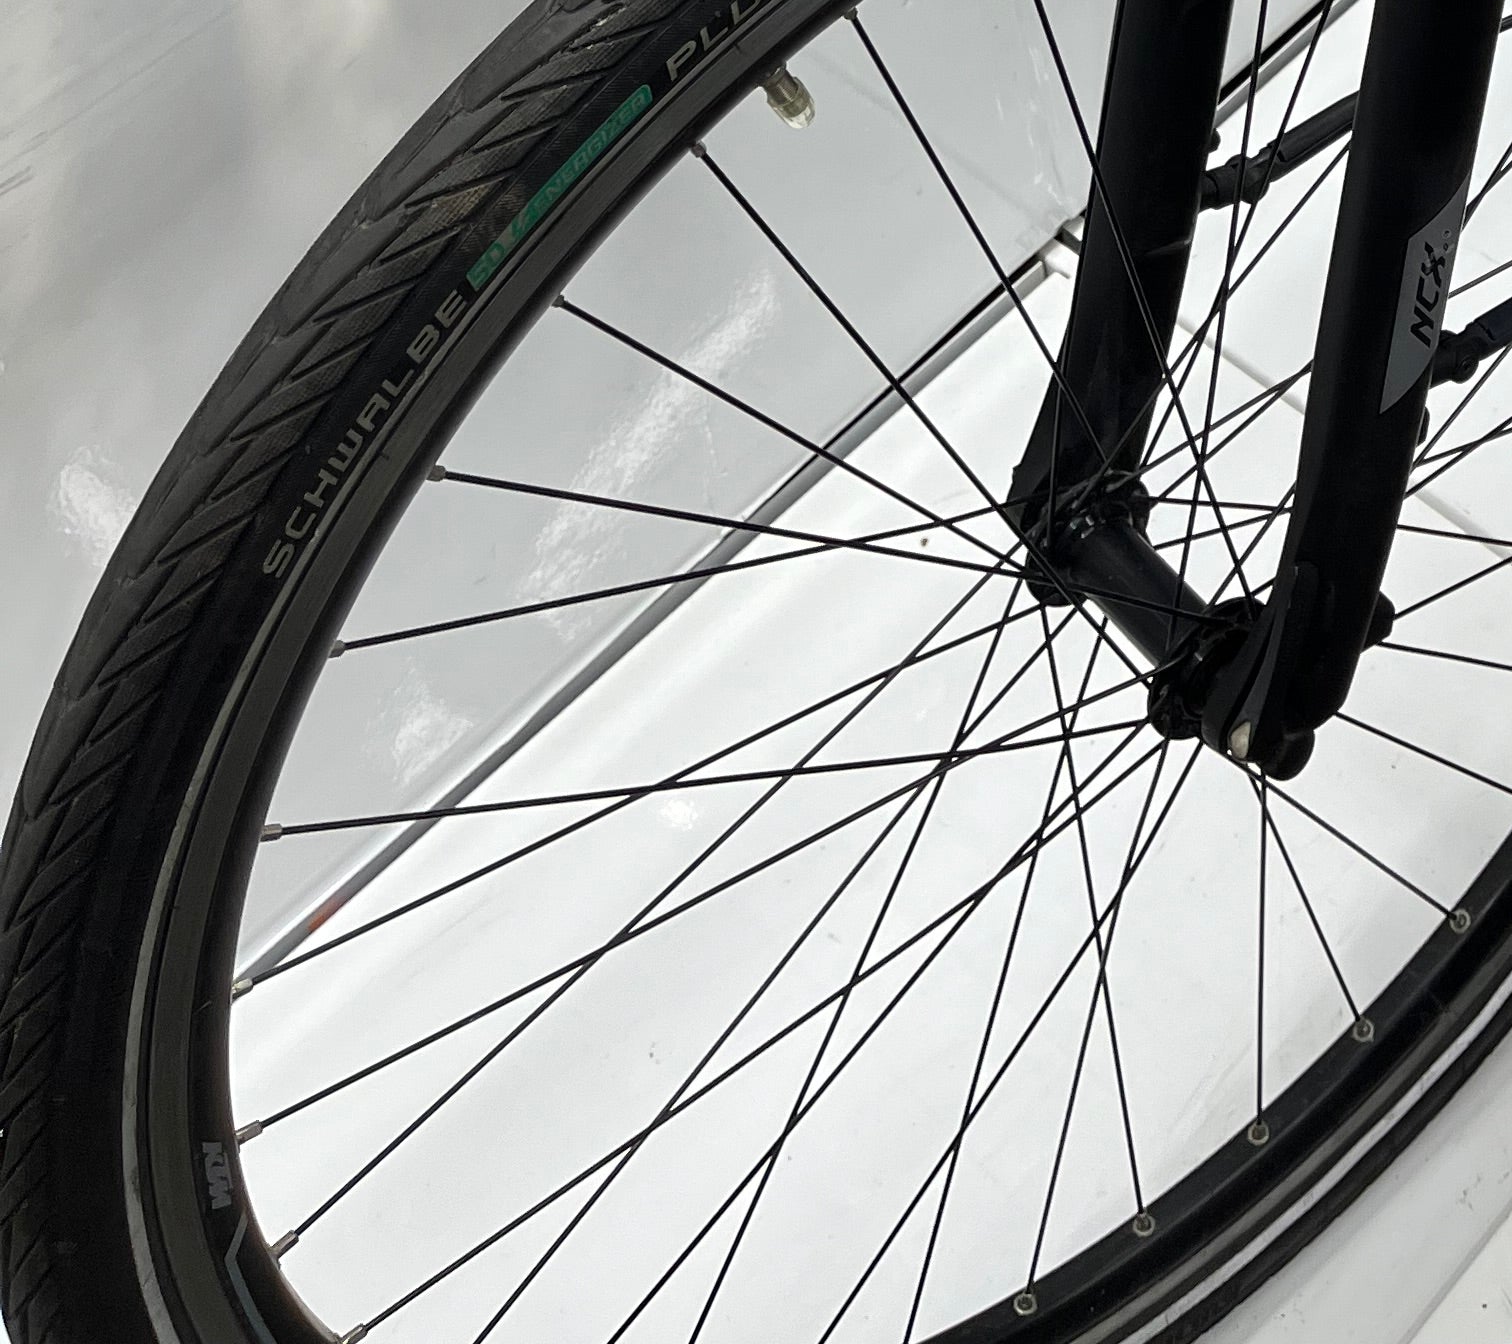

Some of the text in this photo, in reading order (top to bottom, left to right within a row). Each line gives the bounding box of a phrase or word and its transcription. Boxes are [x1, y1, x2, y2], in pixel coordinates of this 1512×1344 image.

[262, 288, 469, 580] SCHWALBE
[534, 88, 652, 217] ENERGIZER
[1409, 241, 1446, 349] NCX
[201, 1141, 233, 1210] KTM
